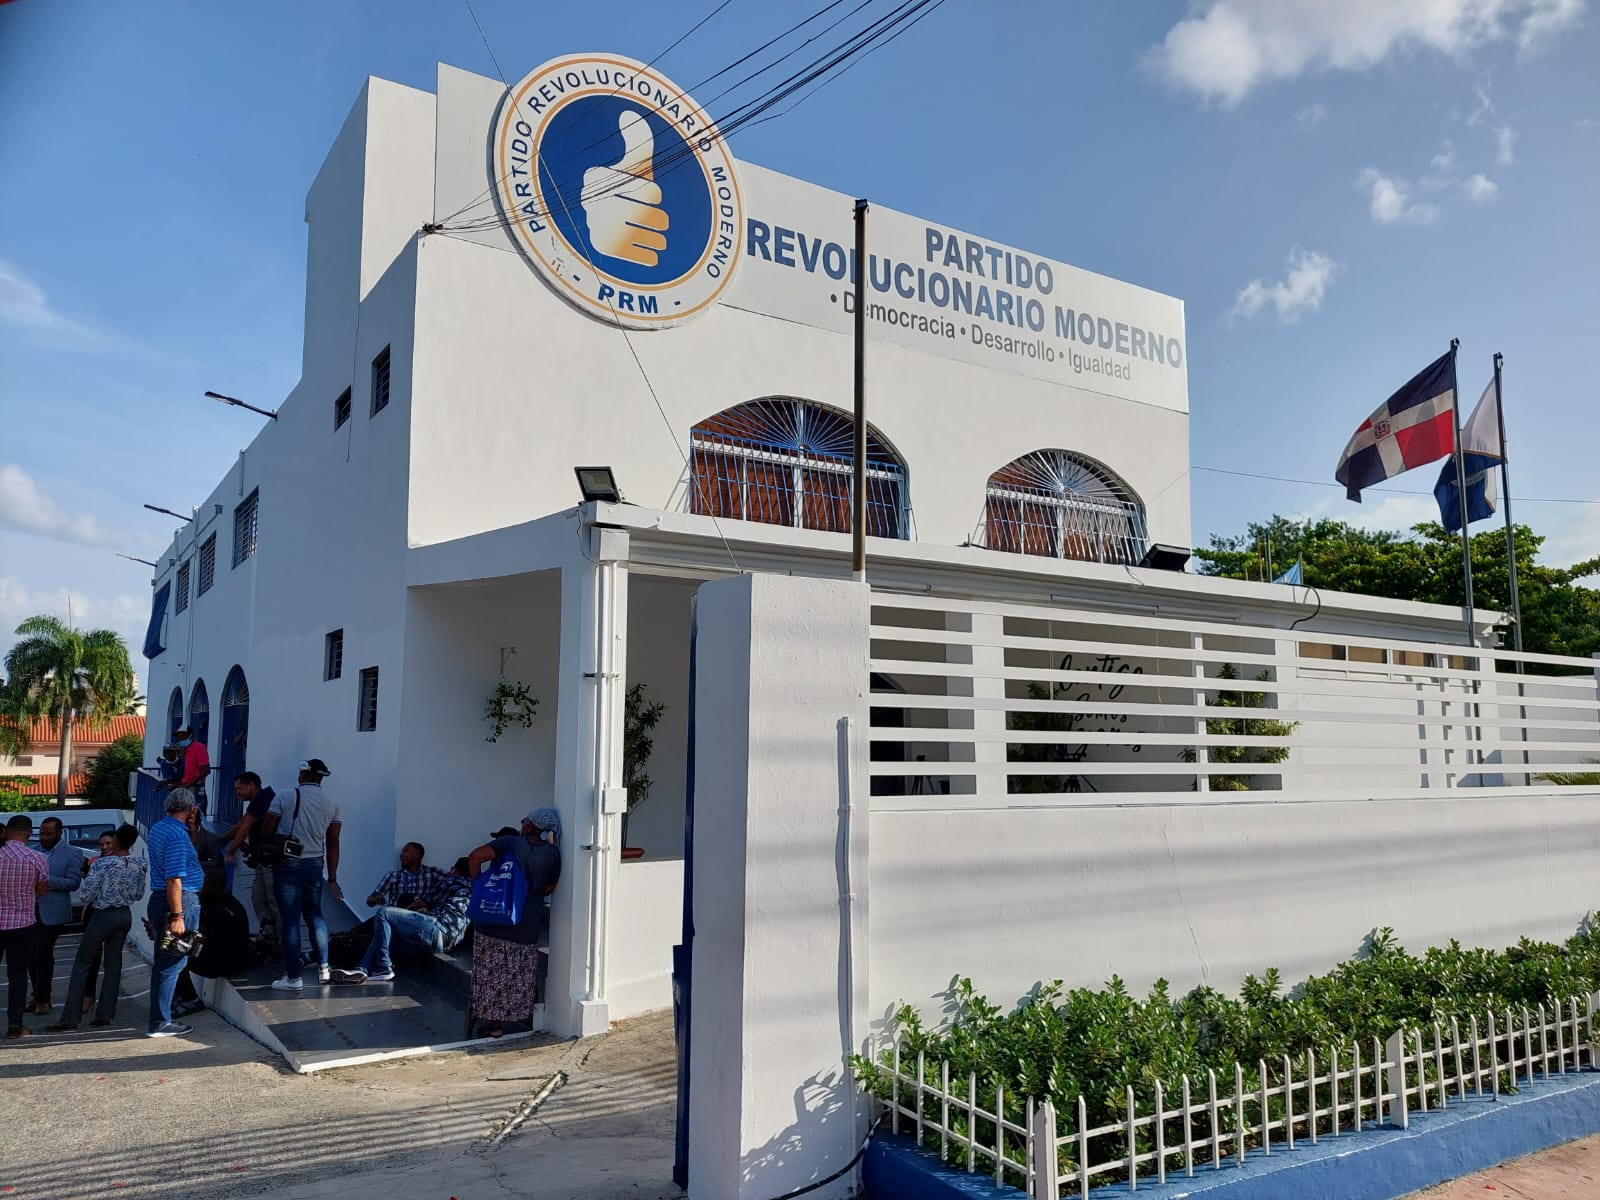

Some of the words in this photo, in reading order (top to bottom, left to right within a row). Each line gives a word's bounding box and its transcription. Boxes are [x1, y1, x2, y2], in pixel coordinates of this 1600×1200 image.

[511, 119, 546, 233] PARTIDO
[706, 166, 734, 279] MODERNO
[925, 227, 1054, 295] PARTIDO
[597, 283, 659, 314] PRM
[843, 290, 956, 340] Dmocracia
[970, 323, 1056, 363] Desarrollo
[1067, 346, 1131, 381] Igualdad
[1054, 305, 1182, 368] MODERNO
